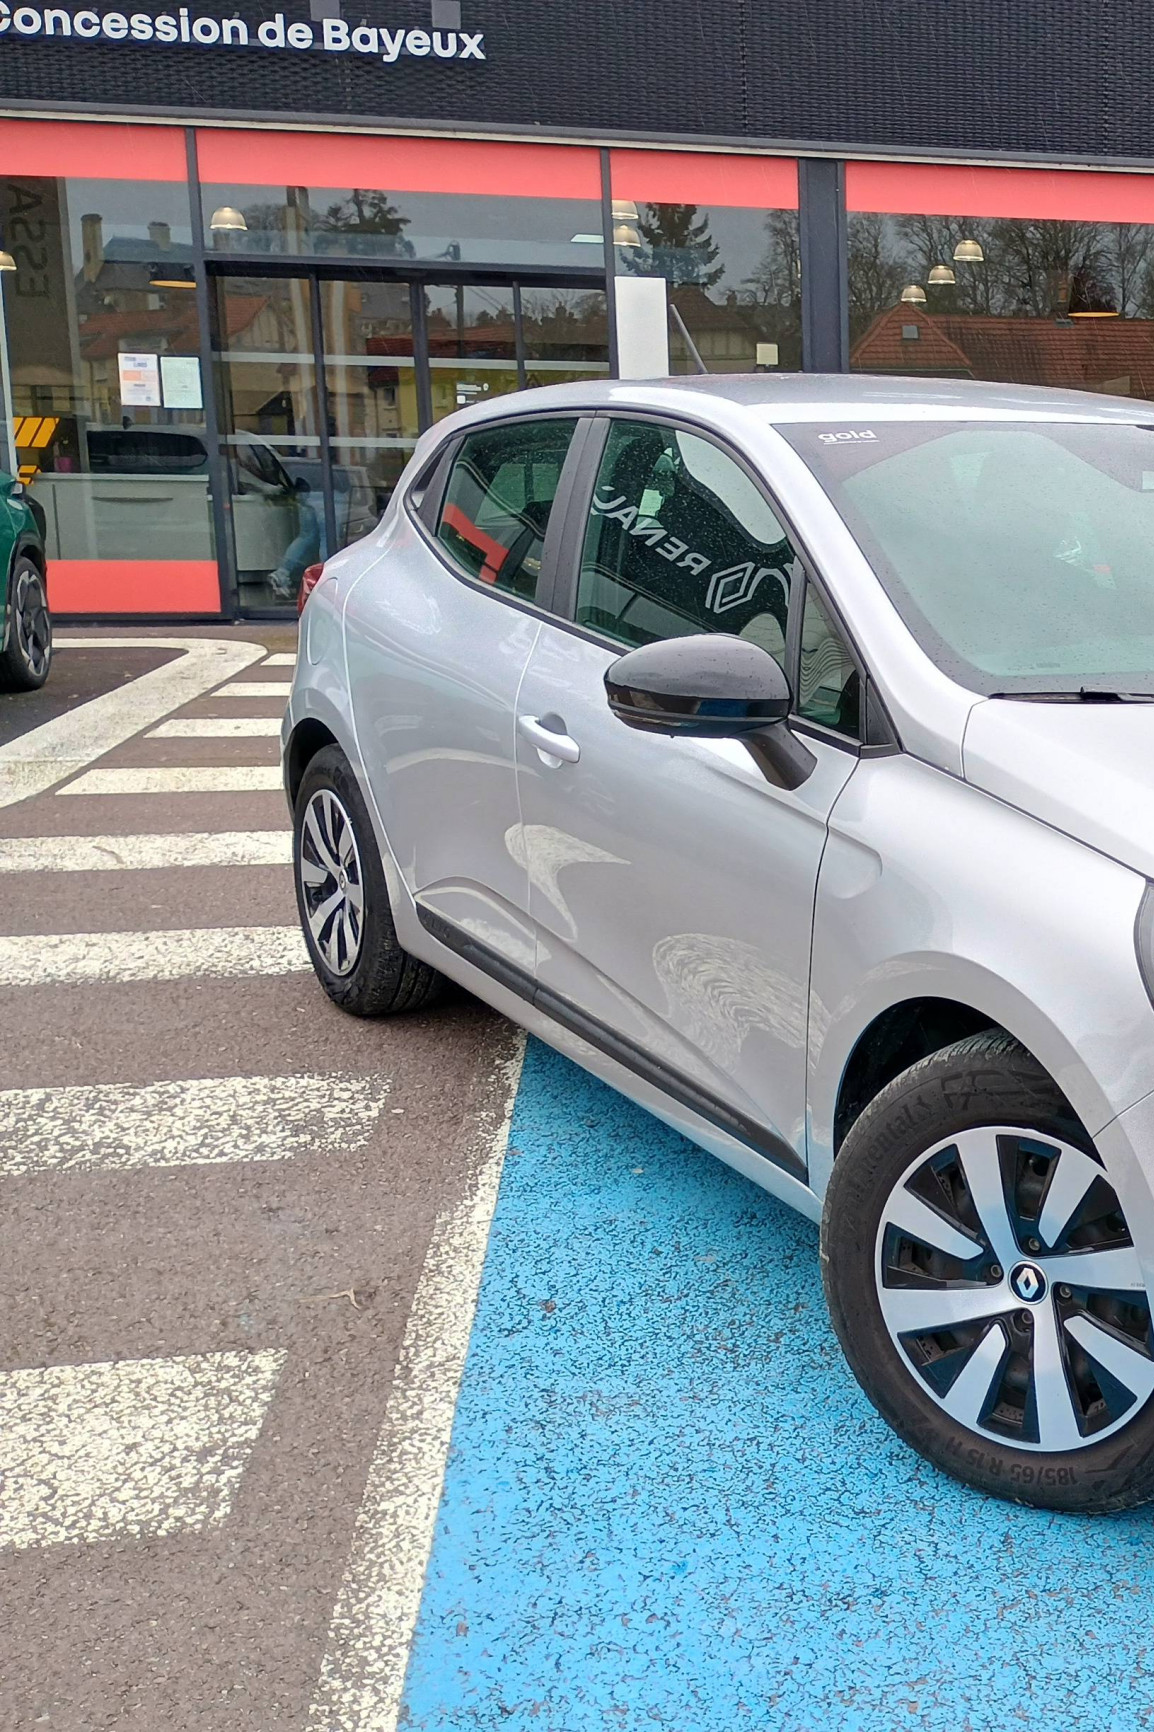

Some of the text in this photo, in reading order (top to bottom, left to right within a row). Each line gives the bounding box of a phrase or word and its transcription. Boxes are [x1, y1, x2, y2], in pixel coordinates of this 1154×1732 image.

[257, 13, 314, 49] de
[322, 18, 487, 63] Bayeux
[818, 430, 877, 442] gold
